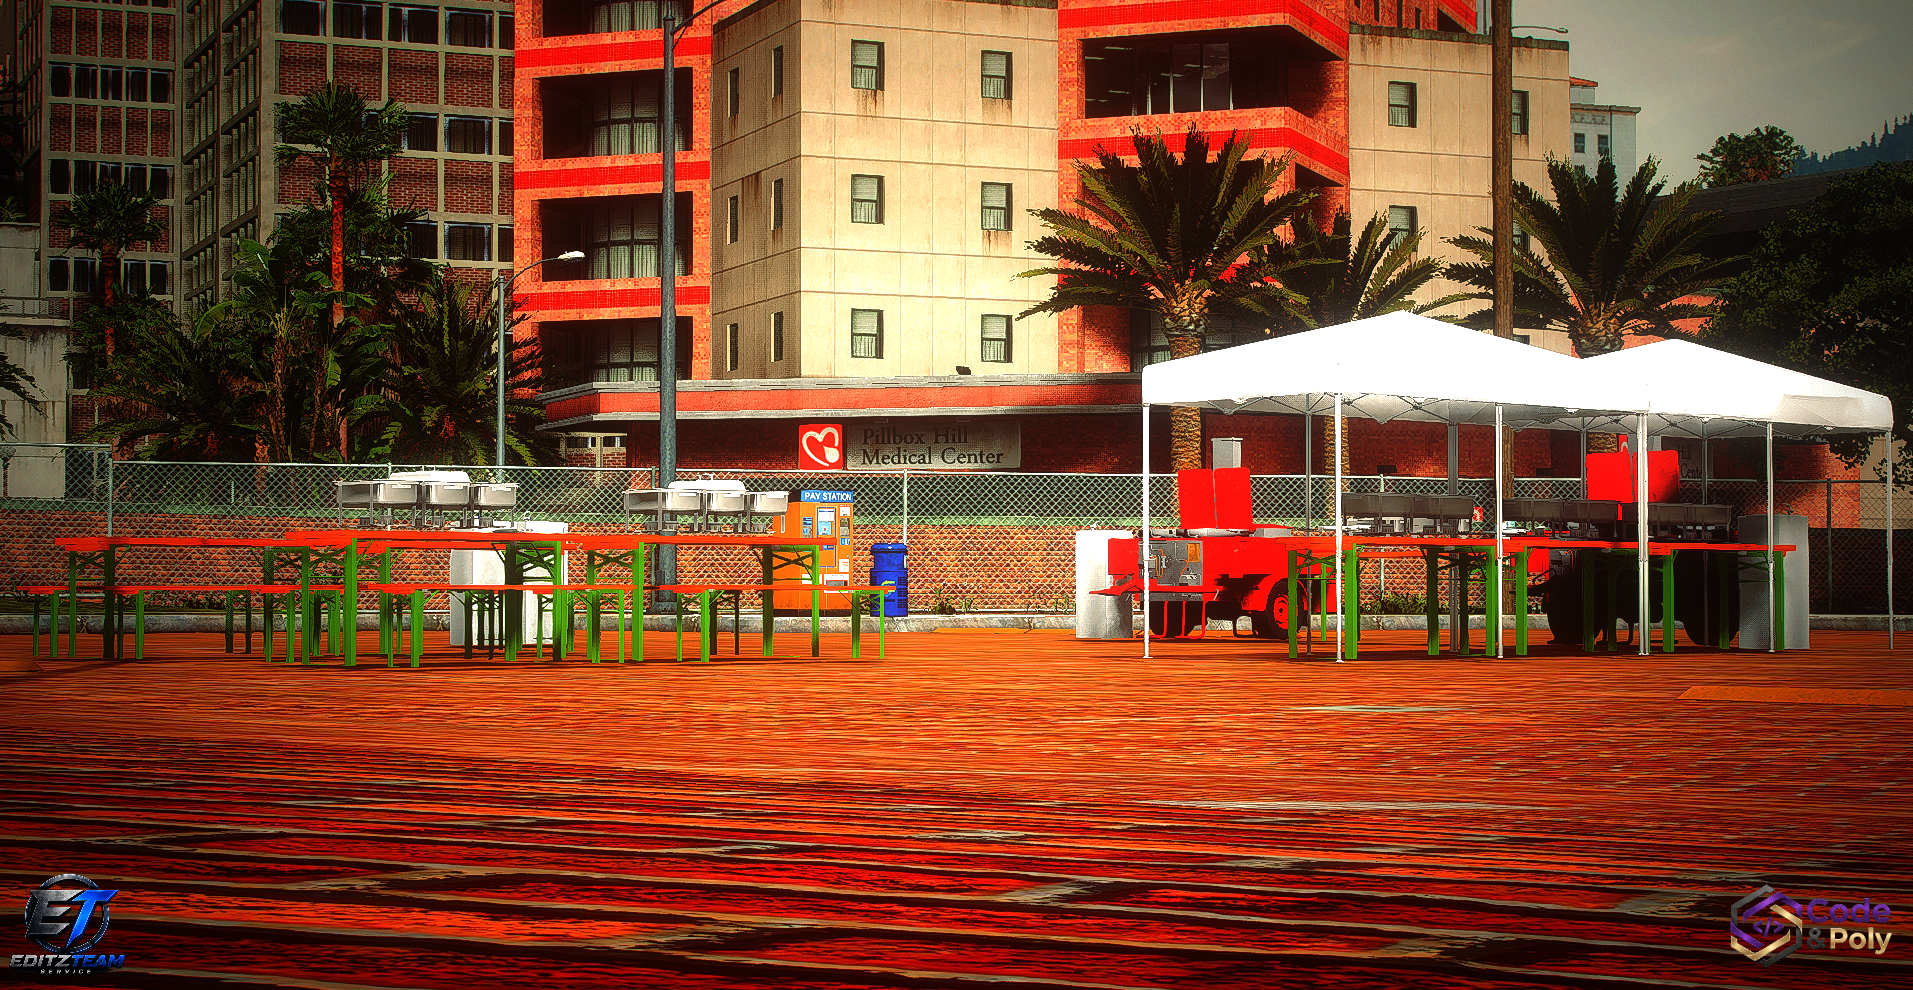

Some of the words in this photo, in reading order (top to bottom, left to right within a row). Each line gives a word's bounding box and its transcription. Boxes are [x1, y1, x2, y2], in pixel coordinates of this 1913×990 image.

[862, 426, 926, 445] Pillbox
[933, 425, 969, 444] Hill
[861, 446, 932, 465] Medical
[941, 447, 1005, 465] Center
[804, 492, 821, 501] PAY
[822, 492, 852, 501] STATION
